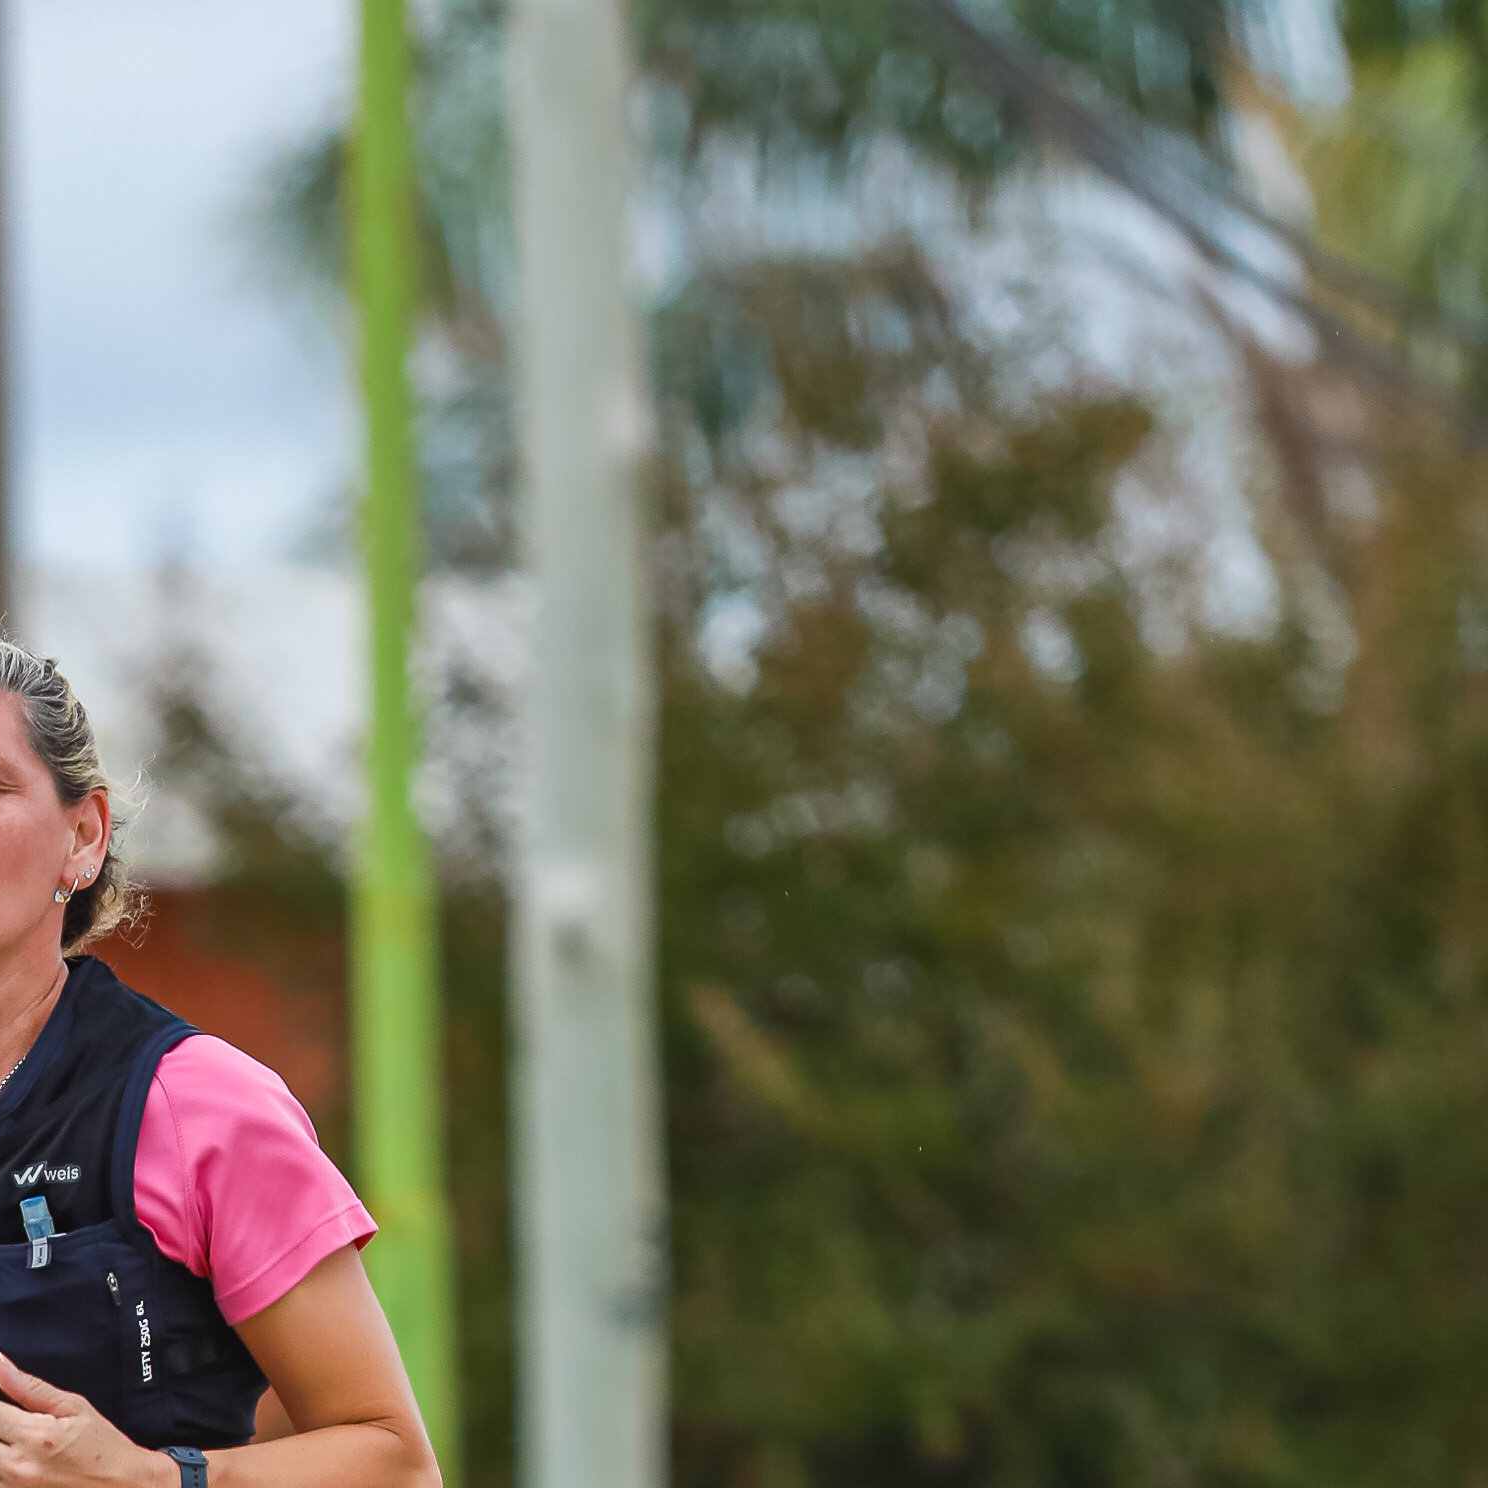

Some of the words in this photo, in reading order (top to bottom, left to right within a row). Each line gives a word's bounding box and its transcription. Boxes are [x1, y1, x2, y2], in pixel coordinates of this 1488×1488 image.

[43, 1166, 79, 1181] weis
[139, 1319, 151, 1347] 250G
[141, 1351, 153, 1382] LEFTY
